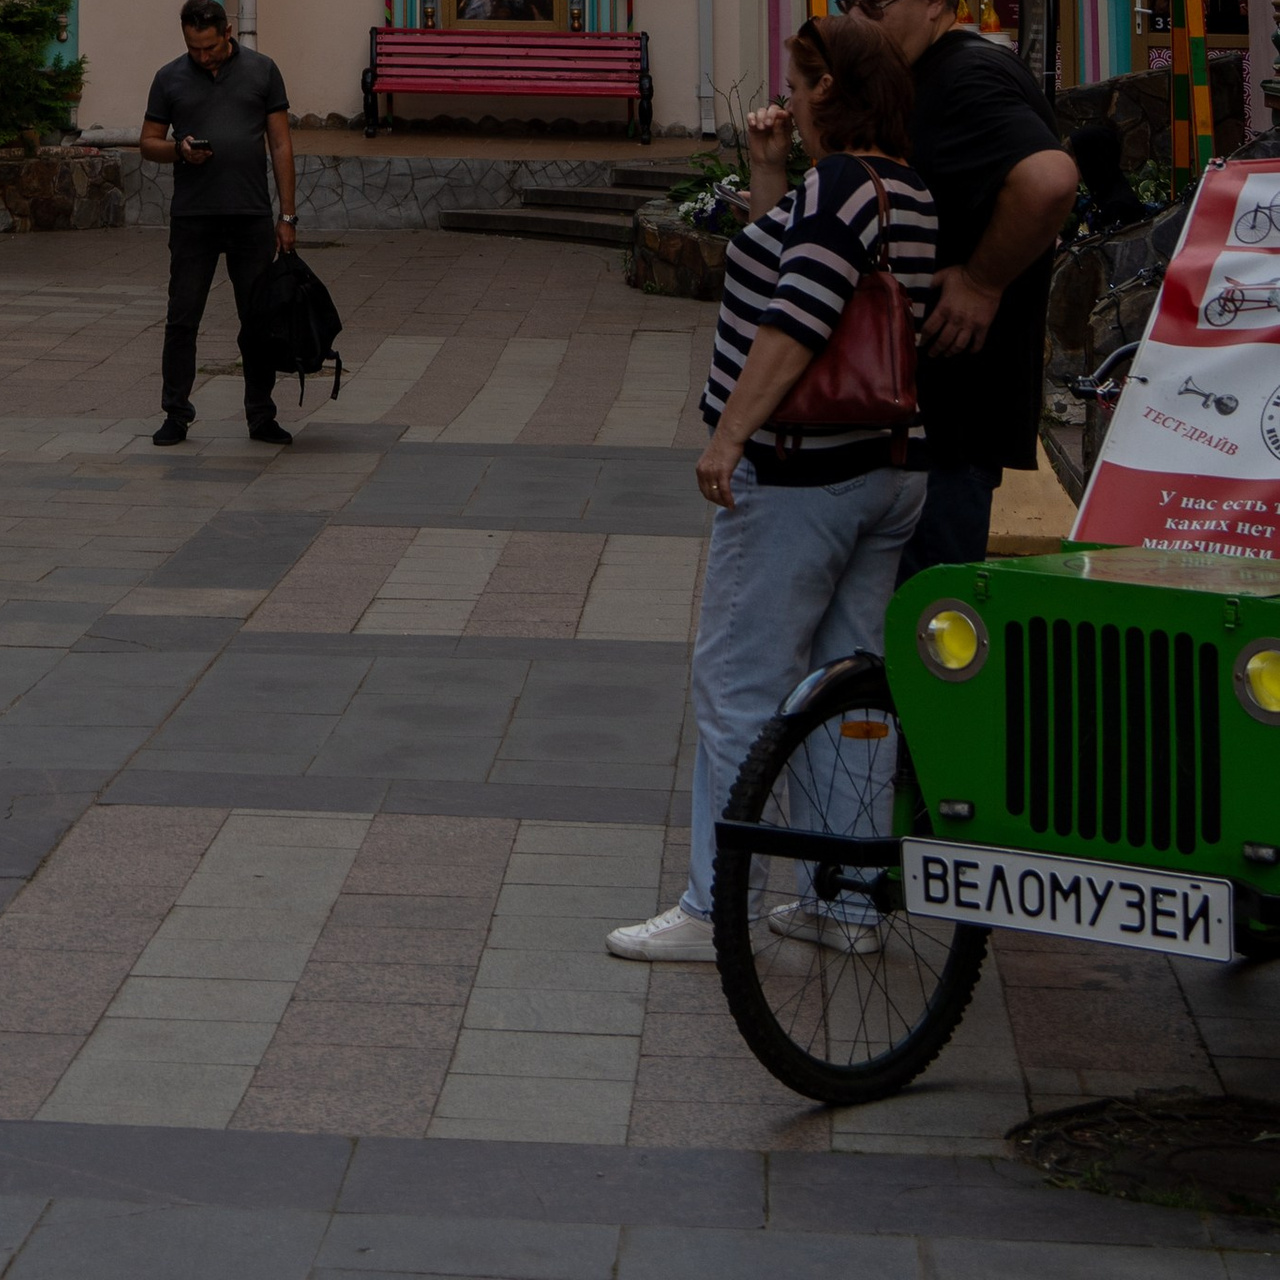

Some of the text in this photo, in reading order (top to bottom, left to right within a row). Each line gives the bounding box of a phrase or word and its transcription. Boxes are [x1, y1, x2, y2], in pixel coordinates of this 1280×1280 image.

[1142, 406, 1239, 456] ТЕСТ-ДРАЙВ
[1159, 490, 1177, 506] У
[1180, 496, 1218, 510] нас
[1222, 499, 1268, 512] есть
[1164, 517, 1276, 538] каких нет
[1141, 537, 1273, 561] мальчишки
[923, 855, 1209, 944] ВЕЛОМУЗЕЙ
